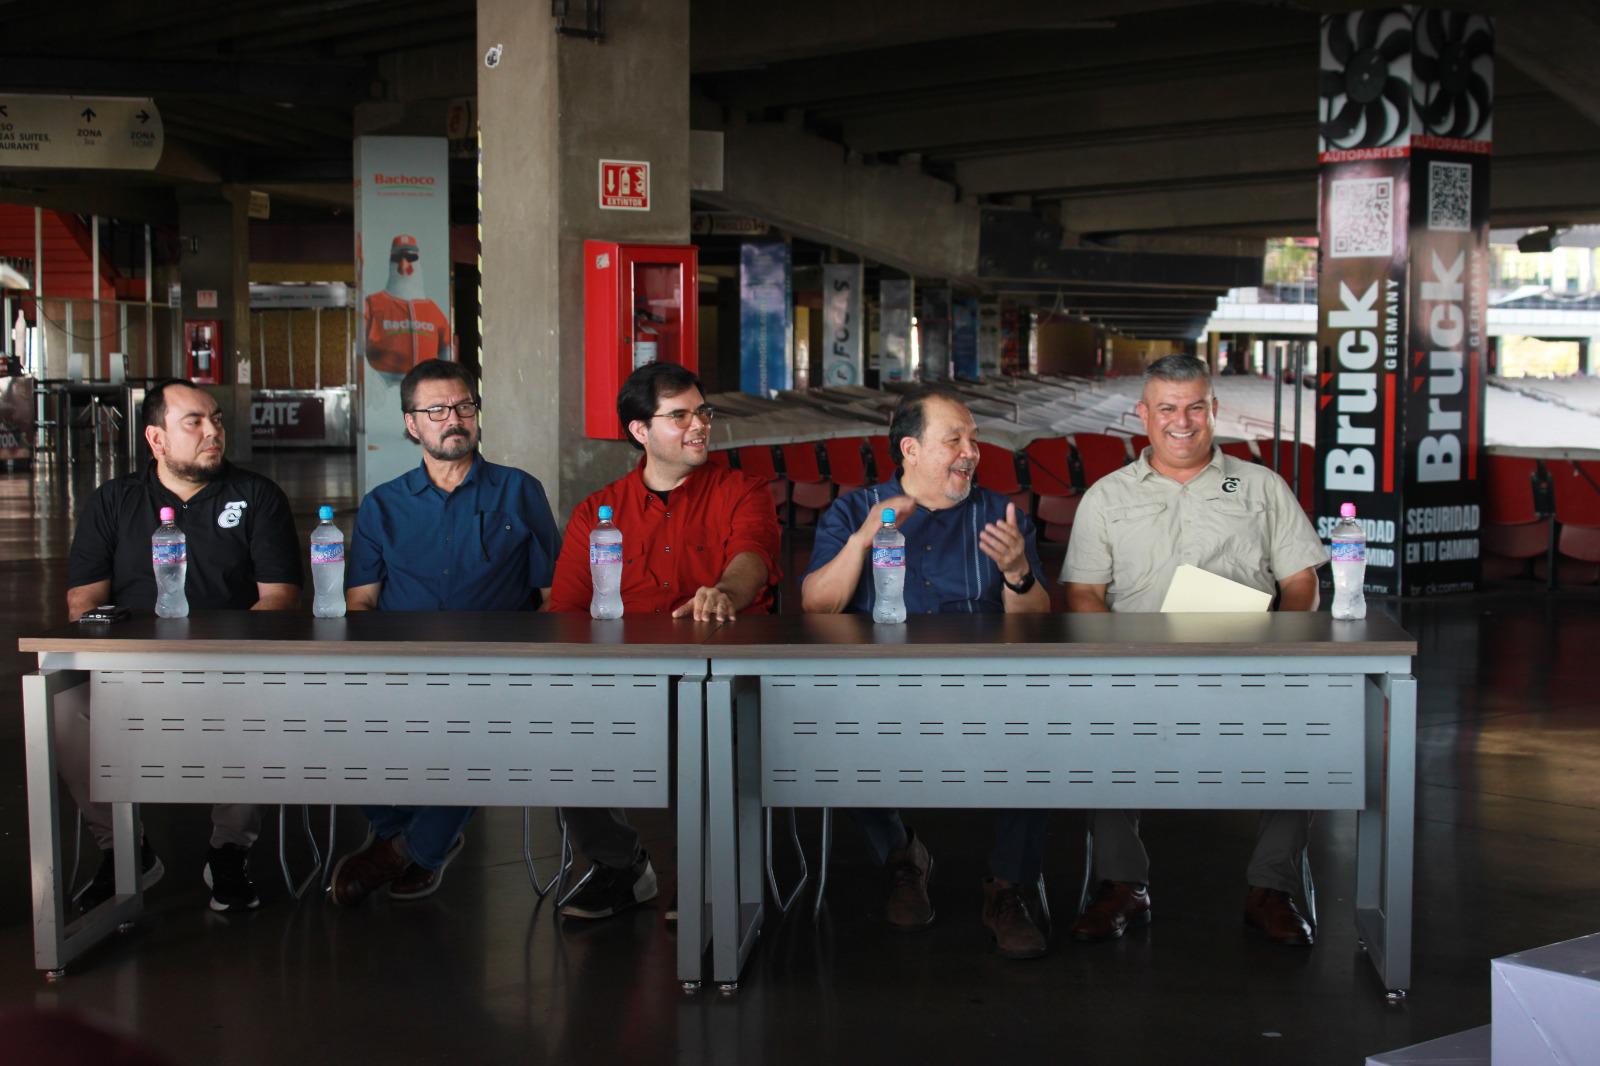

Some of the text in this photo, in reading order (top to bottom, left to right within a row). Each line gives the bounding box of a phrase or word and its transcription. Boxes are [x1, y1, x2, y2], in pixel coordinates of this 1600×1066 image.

[77, 128, 103, 137] ZONA
[130, 131, 155, 140] ZONA
[1413, 136, 1488, 153] AUTOPARTES
[1323, 149, 1405, 162] AUTOPARTES
[374, 173, 434, 185] Bachoco
[607, 197, 642, 207] EXTINTOR
[1469, 250, 1482, 347] GERMANY
[1384, 278, 1399, 370] GERMANY
[1412, 250, 1466, 482] Brück
[1320, 280, 1379, 492] Brück
[1407, 504, 1480, 535] SEGURIDAD
[1406, 538, 1480, 564] EN TU CAMINO
